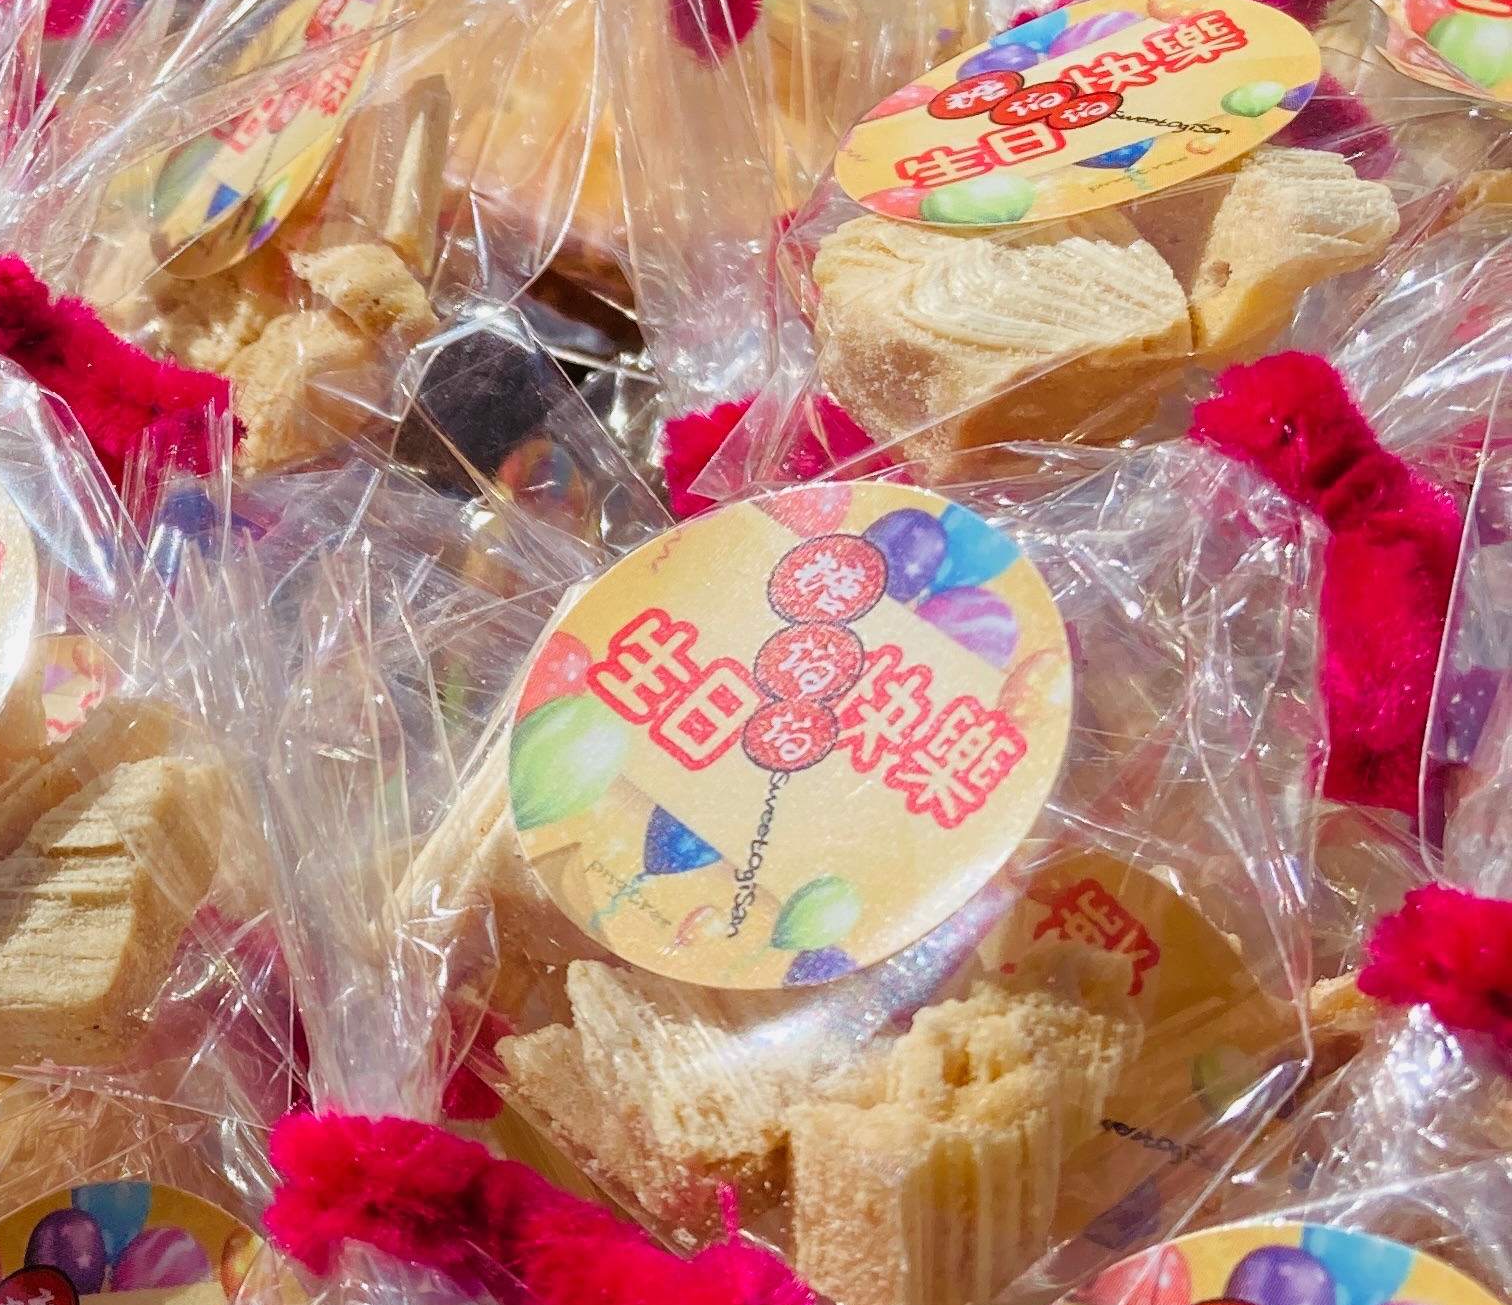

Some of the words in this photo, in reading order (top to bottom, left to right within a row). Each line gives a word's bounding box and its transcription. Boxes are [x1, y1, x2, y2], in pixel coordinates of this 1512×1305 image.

[895, 122, 1065, 188] 生日
[1059, 9, 1249, 92] 快樂
[944, 75, 1110, 127] 糖伯伯
[587, 607, 762, 771] 生日
[830, 645, 1027, 829] 快樂
[760, 548, 867, 765] 糖伯伯
